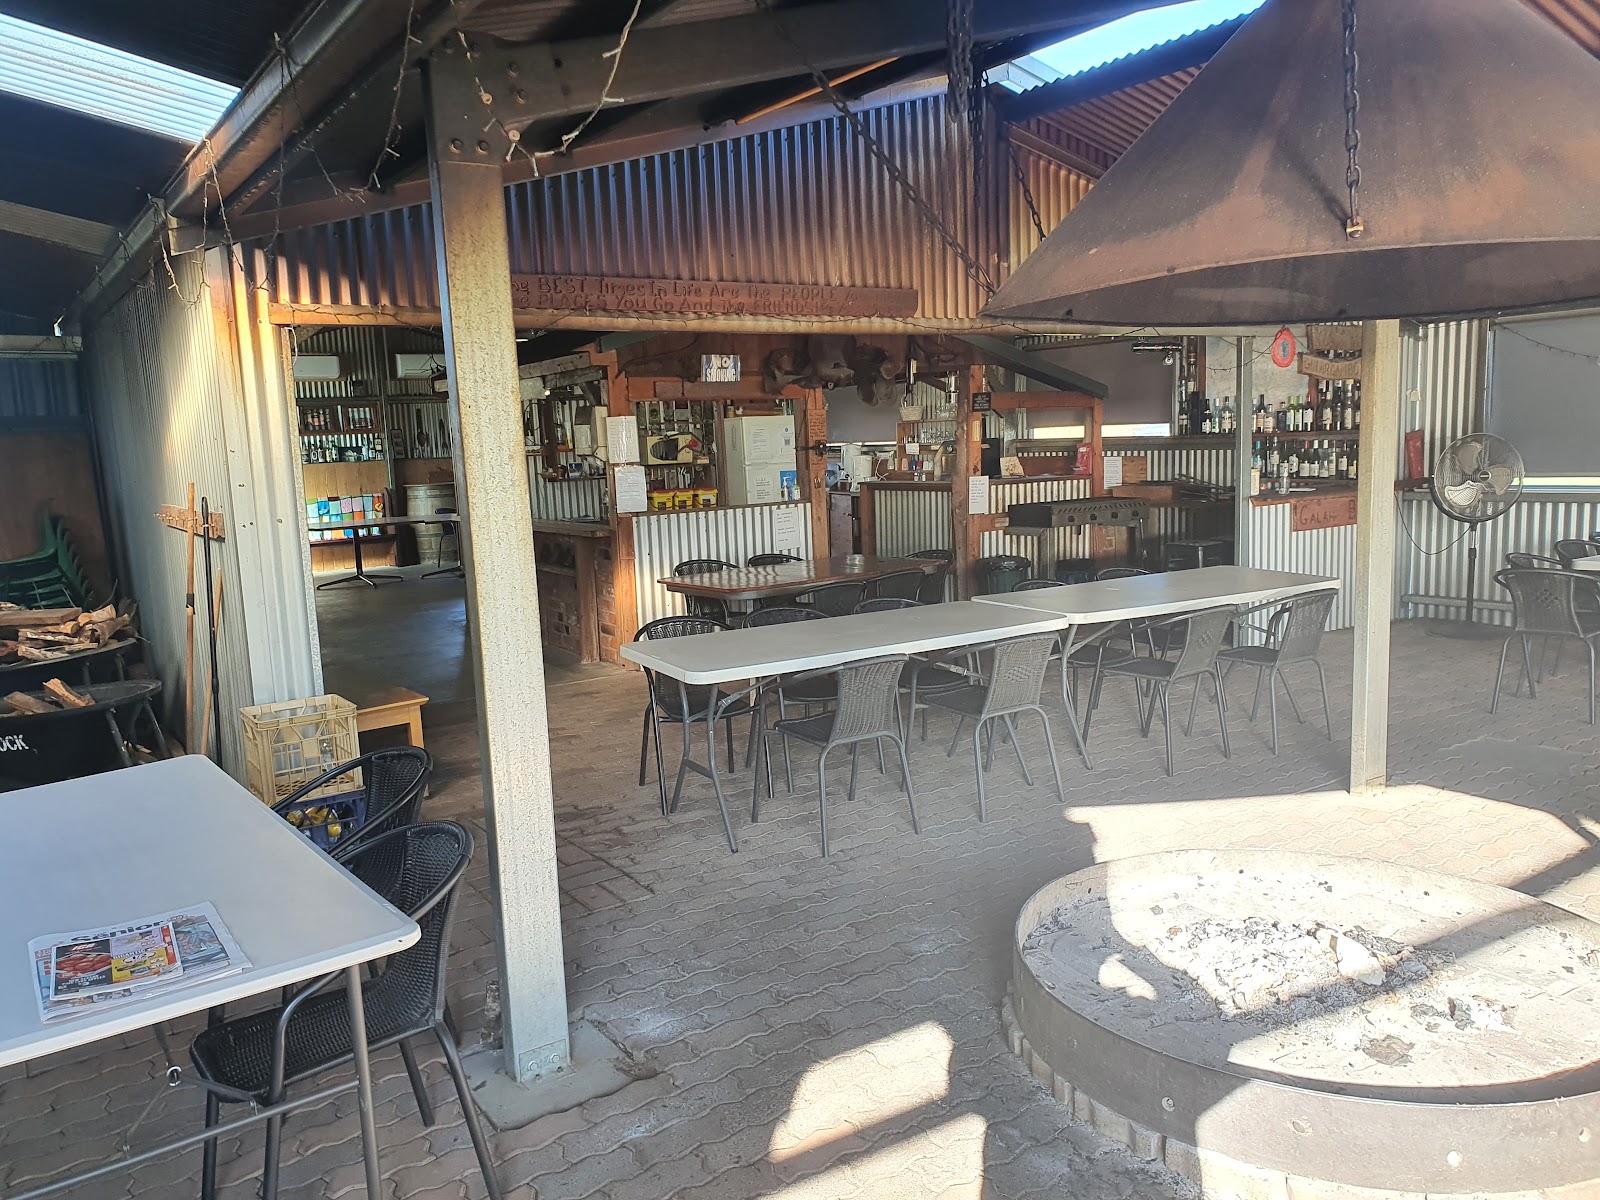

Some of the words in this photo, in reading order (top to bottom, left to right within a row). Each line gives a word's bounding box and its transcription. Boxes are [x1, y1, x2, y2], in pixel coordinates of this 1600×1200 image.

[540, 276, 588, 294] BEST
[673, 281, 702, 297] Life
[710, 283, 740, 299] Are
[748, 285, 771, 299] The
[781, 286, 838, 302] PEOPLE
[680, 298, 713, 312] And
[711, 355, 731, 368] NO
[706, 368, 736, 382] SMOKING
